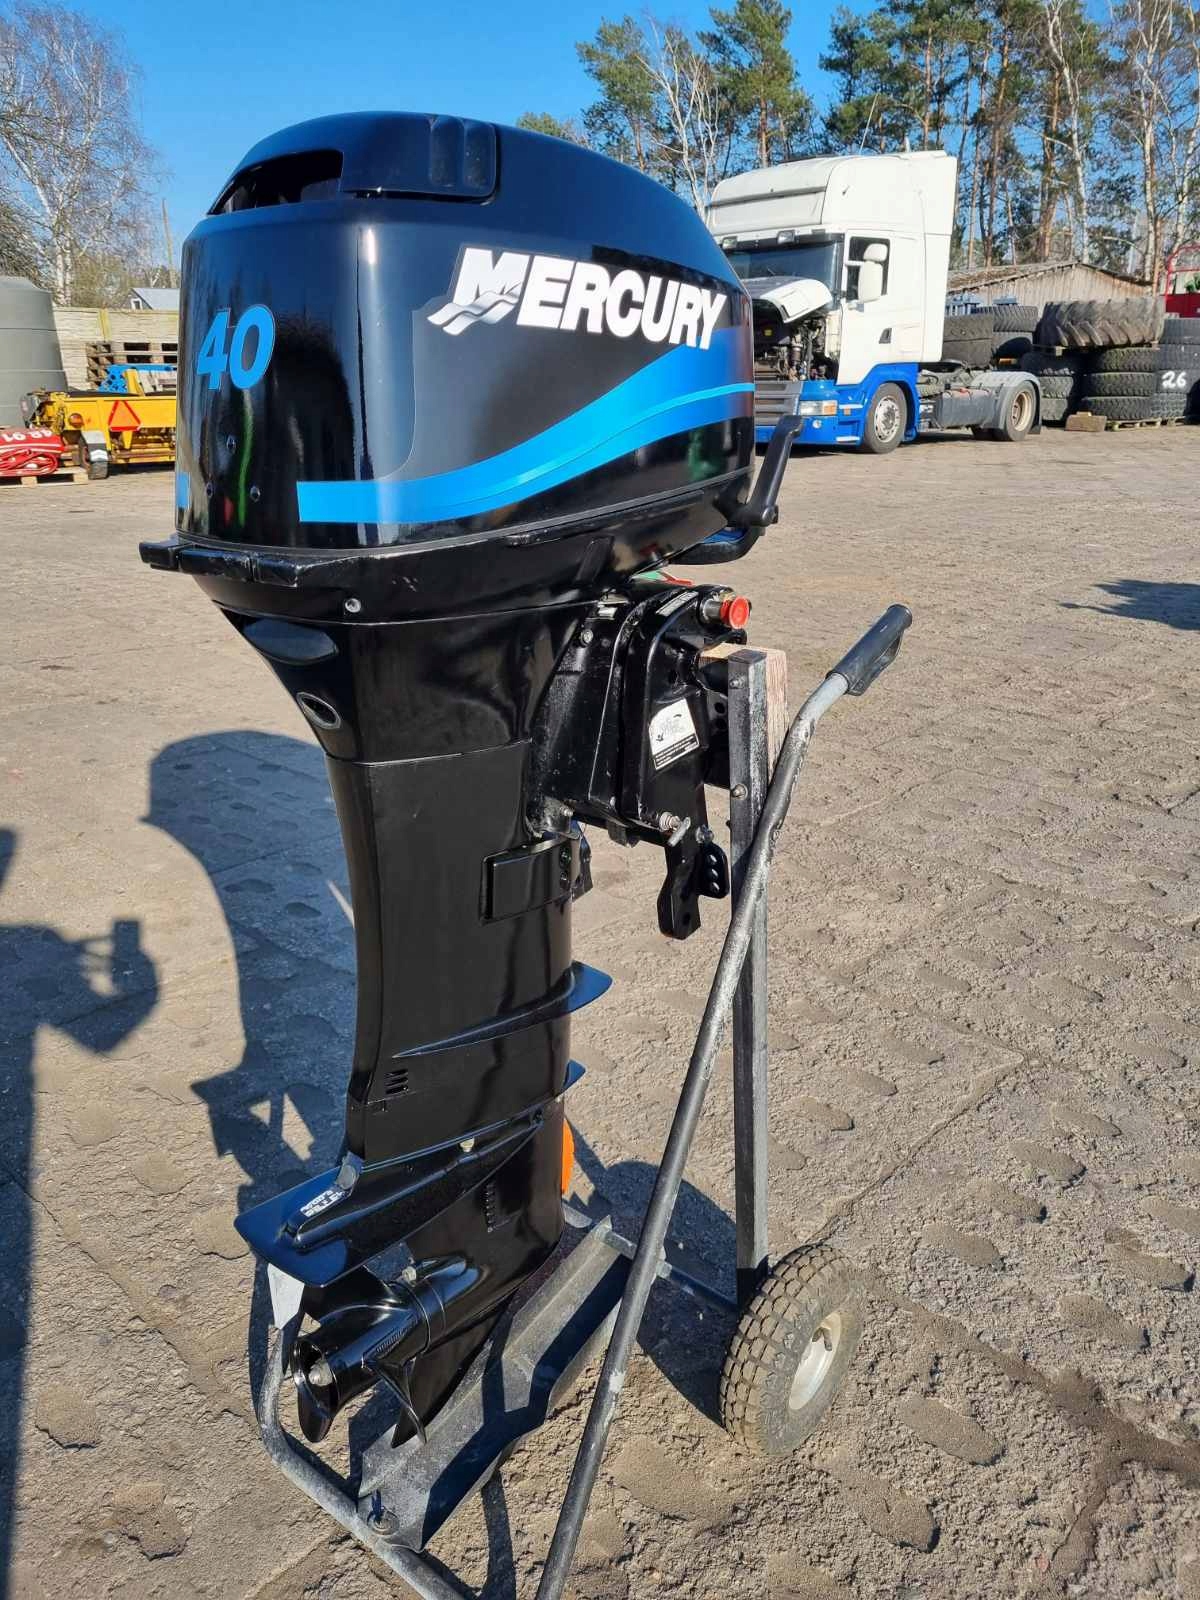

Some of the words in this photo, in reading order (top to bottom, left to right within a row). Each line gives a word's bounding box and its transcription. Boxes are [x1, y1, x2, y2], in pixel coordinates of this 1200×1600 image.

[450, 247, 727, 350] MERCURY
[197, 305, 275, 390] 40
[1161, 370, 1186, 389] 26
